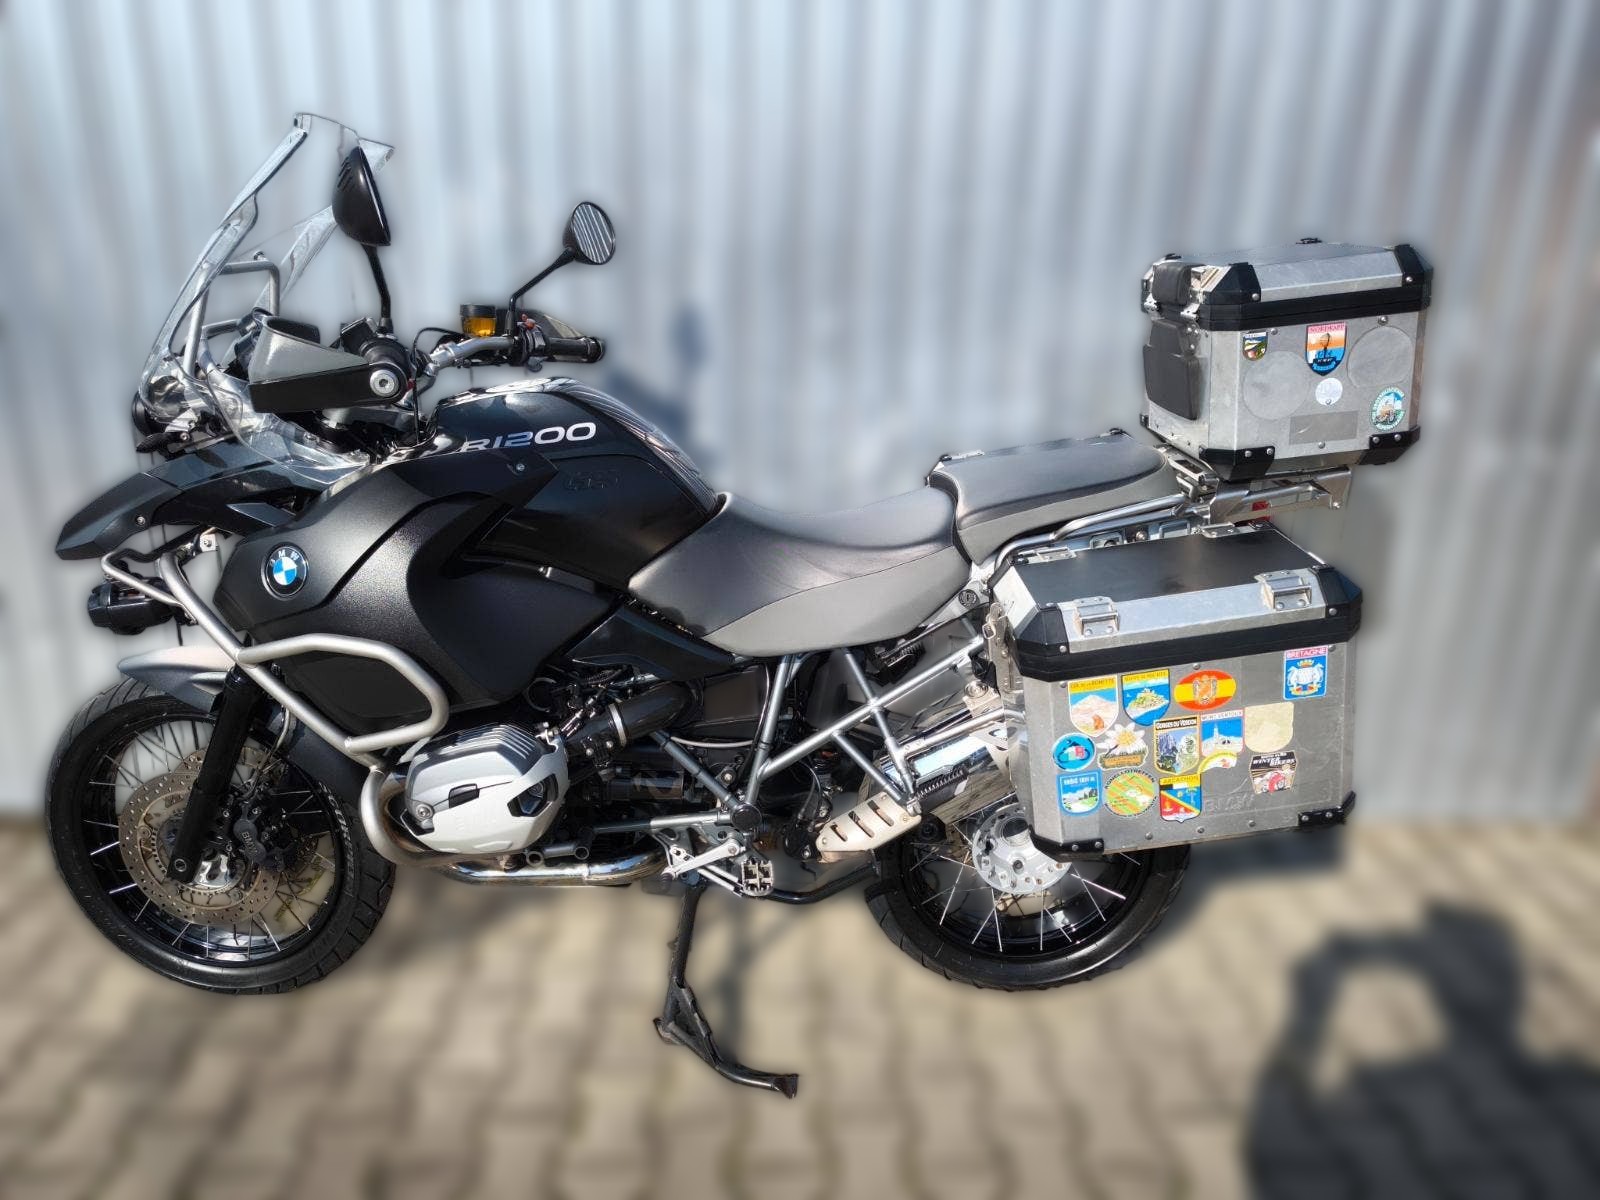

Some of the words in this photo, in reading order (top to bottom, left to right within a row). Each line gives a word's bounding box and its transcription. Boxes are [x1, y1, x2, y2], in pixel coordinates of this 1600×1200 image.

[1309, 324, 1345, 334] NORDKAPP
[459, 422, 597, 452] R1200
[1286, 647, 1327, 659] BRETAGNE
[1253, 757, 1280, 765] WINTER
